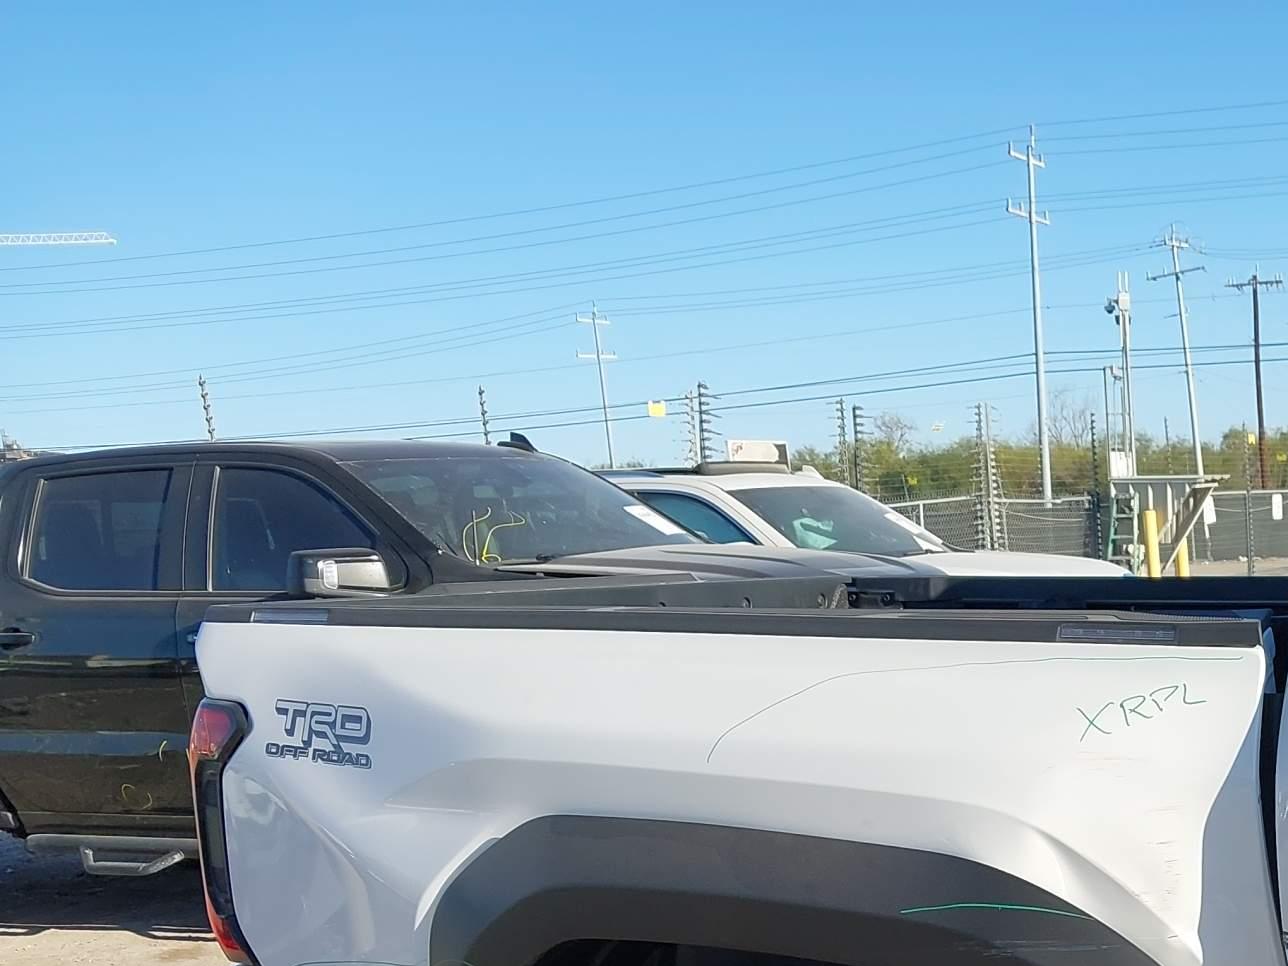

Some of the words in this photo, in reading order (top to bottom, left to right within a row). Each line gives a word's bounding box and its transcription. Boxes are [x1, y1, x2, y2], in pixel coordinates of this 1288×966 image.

[275, 698, 372, 752] TRD
[265, 743, 309, 760] OFF
[312, 748, 372, 769] ROAD
